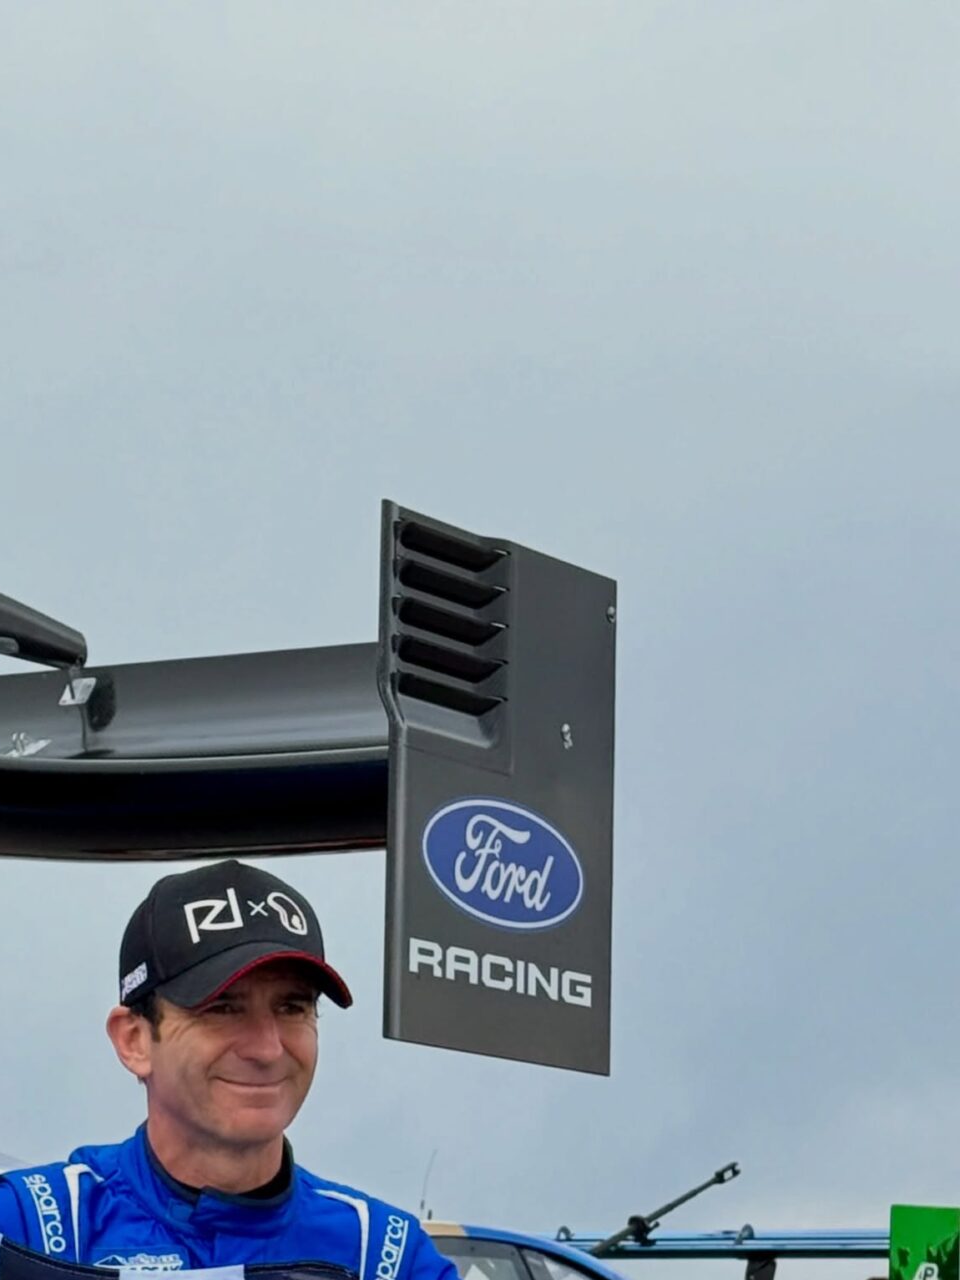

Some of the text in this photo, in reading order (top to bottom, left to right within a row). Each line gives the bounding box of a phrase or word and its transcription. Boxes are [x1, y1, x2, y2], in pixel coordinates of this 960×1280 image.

[454, 813, 554, 912] Ford
[408, 937, 592, 1008] RACING
[24, 1174, 67, 1254] sparco
